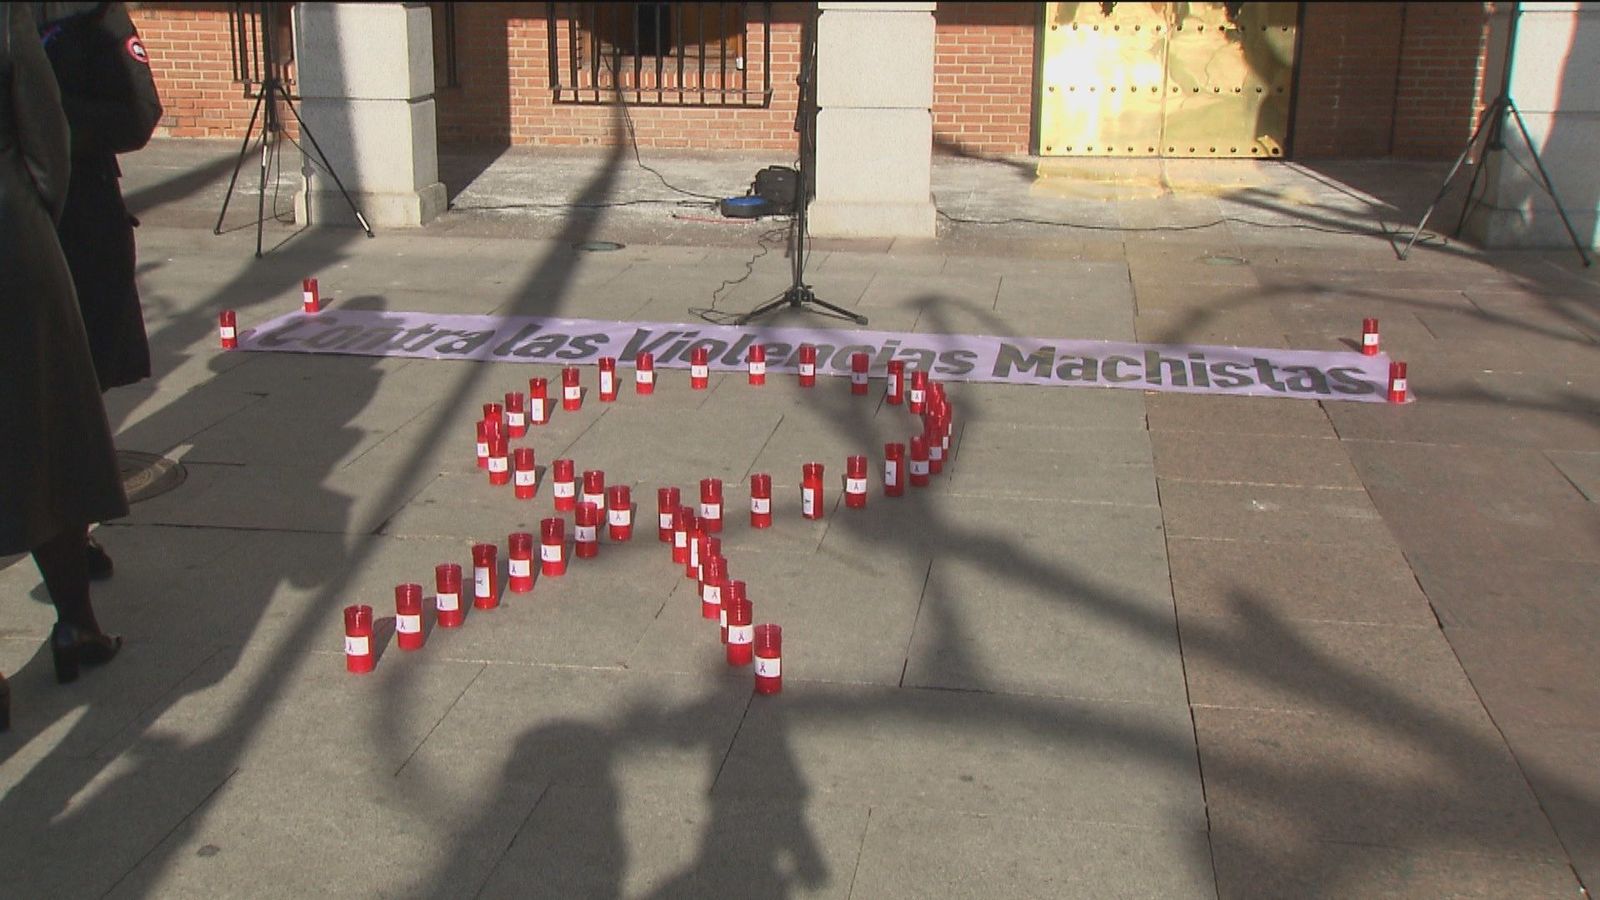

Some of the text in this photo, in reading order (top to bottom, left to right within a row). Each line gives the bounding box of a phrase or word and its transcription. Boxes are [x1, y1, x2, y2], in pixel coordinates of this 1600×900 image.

[257, 315, 1376, 394] Contra las Violencias Machistas
